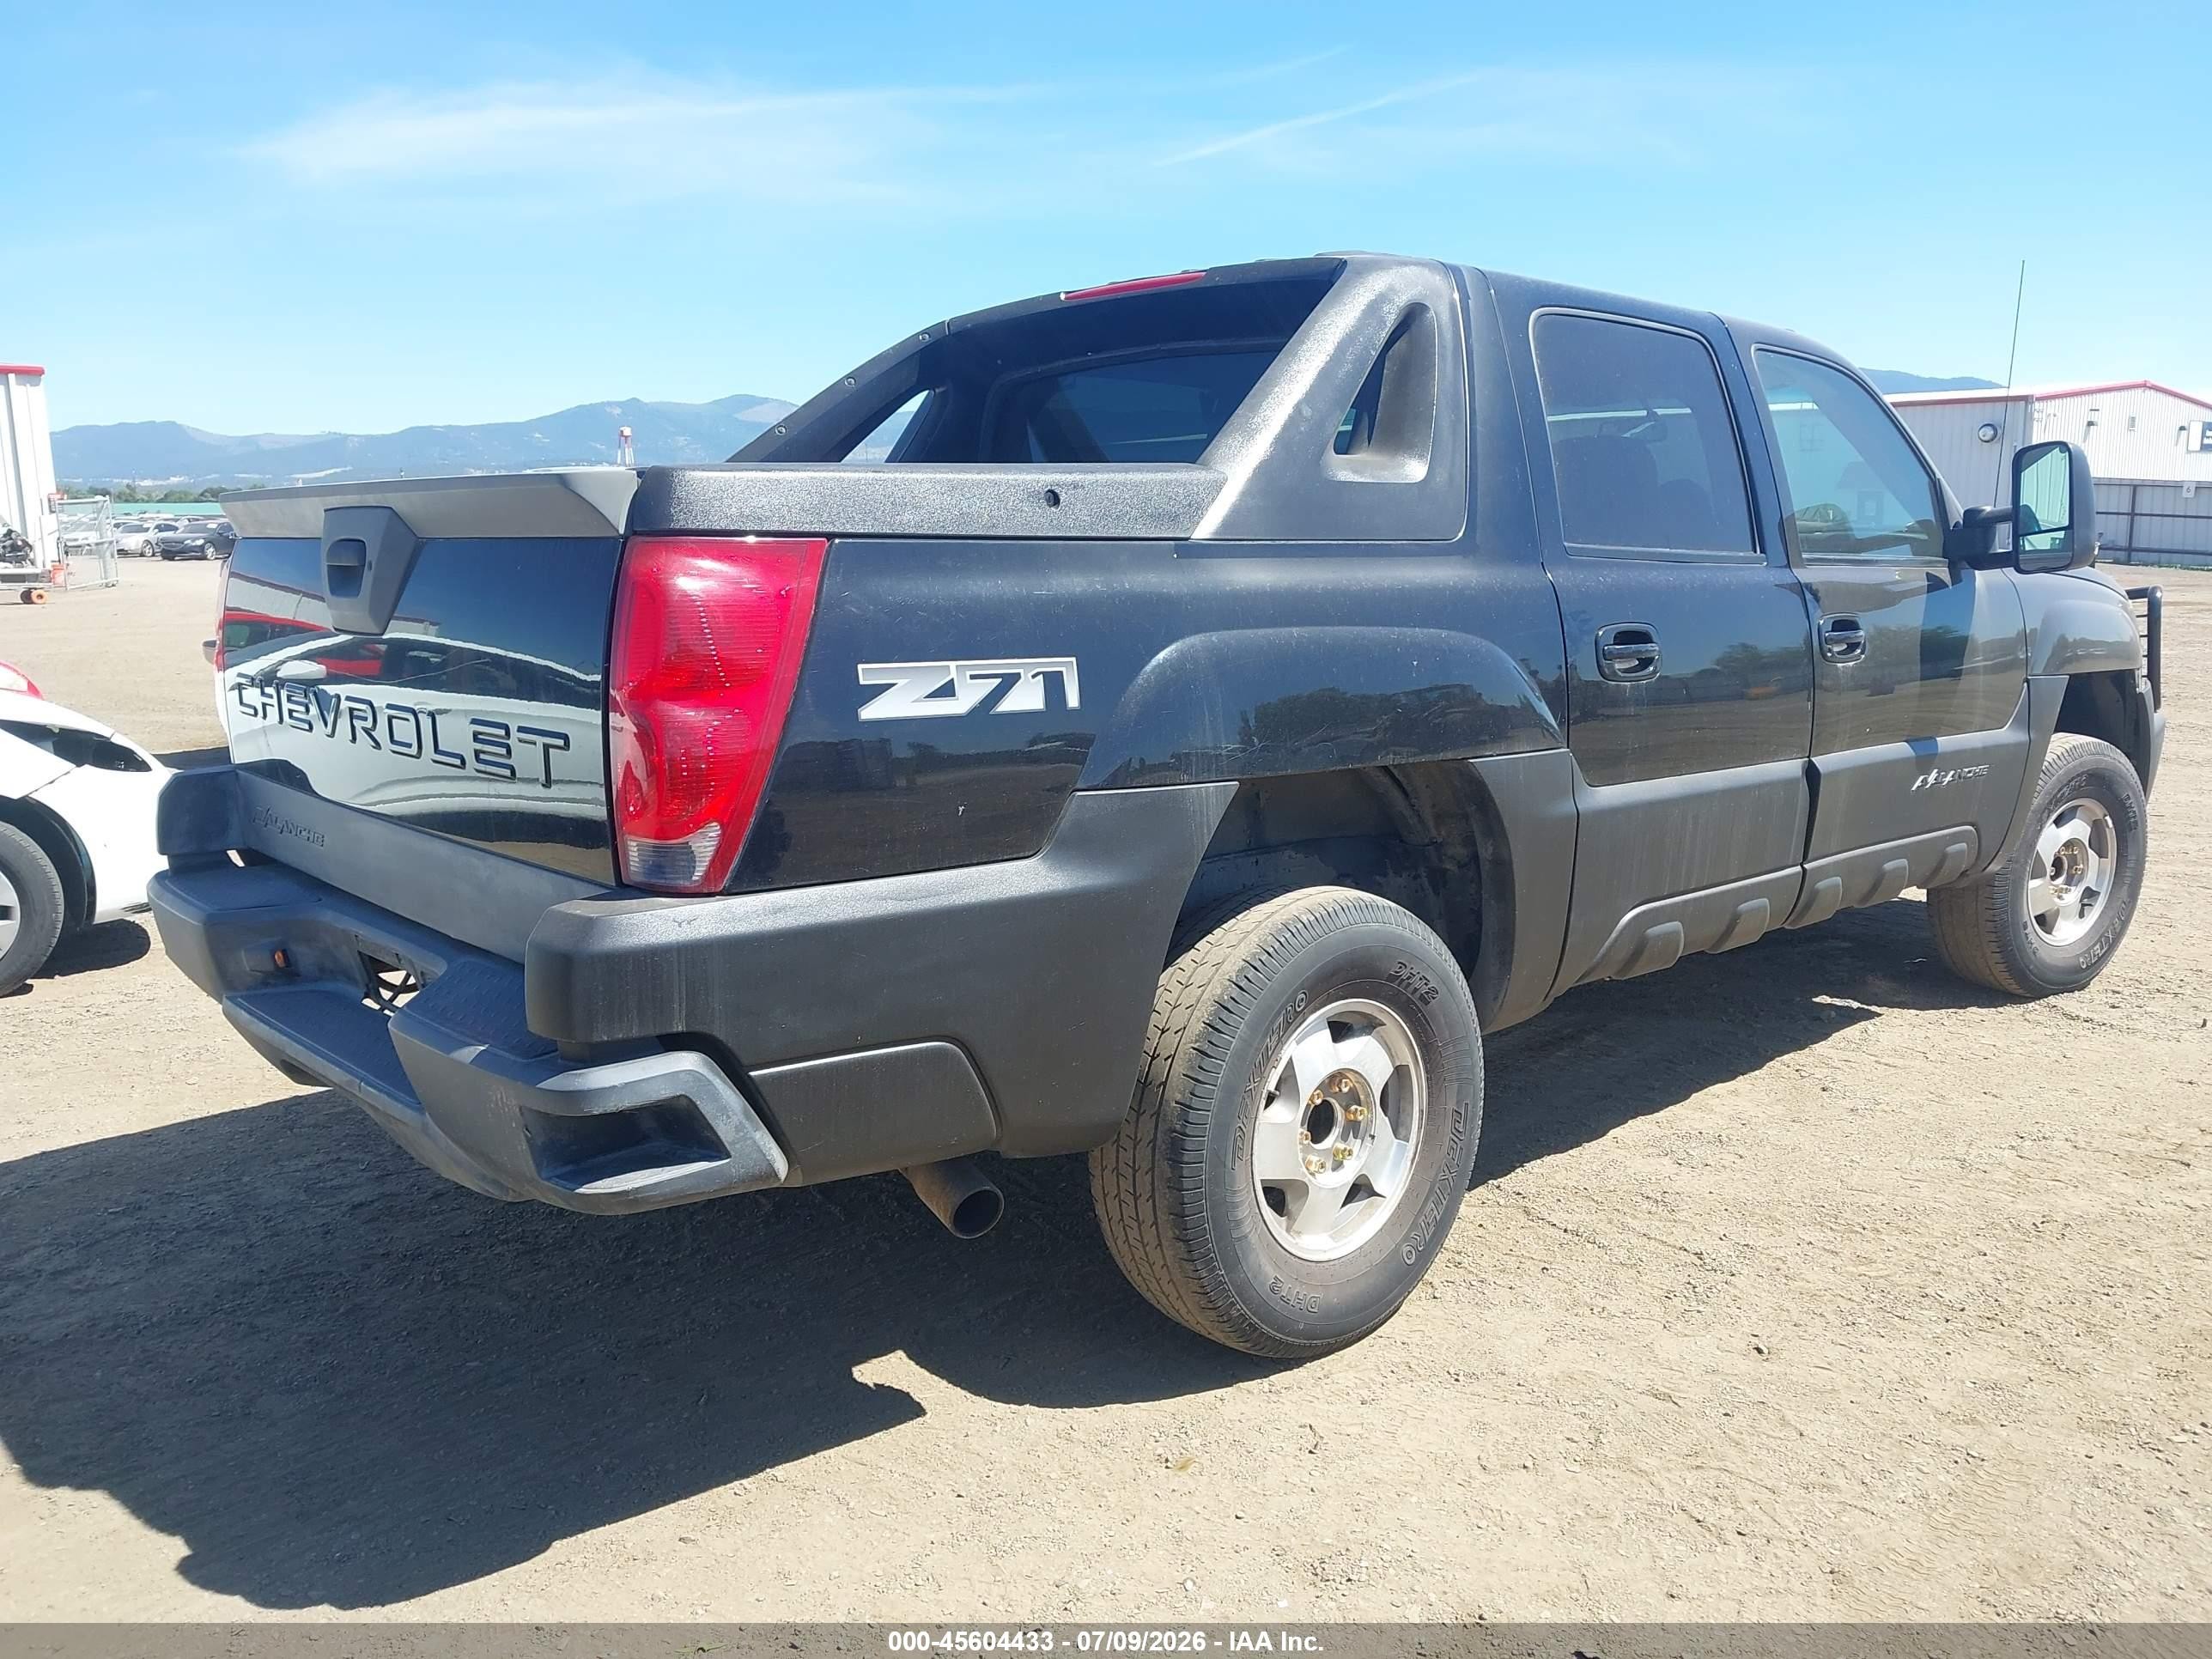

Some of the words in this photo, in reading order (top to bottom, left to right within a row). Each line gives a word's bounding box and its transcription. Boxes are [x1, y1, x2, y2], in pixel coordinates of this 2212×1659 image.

[2185, 485, 2191, 494] 6
[857, 656, 1080, 721] Z71
[235, 672, 570, 788] CHEVROLET
[1911, 764, 1990, 791] AVALANCHE
[252, 805, 325, 848] AVALANCHE
[1390, 960, 1441, 1006] DHT2
[1268, 1274, 1324, 1315] DHT2
